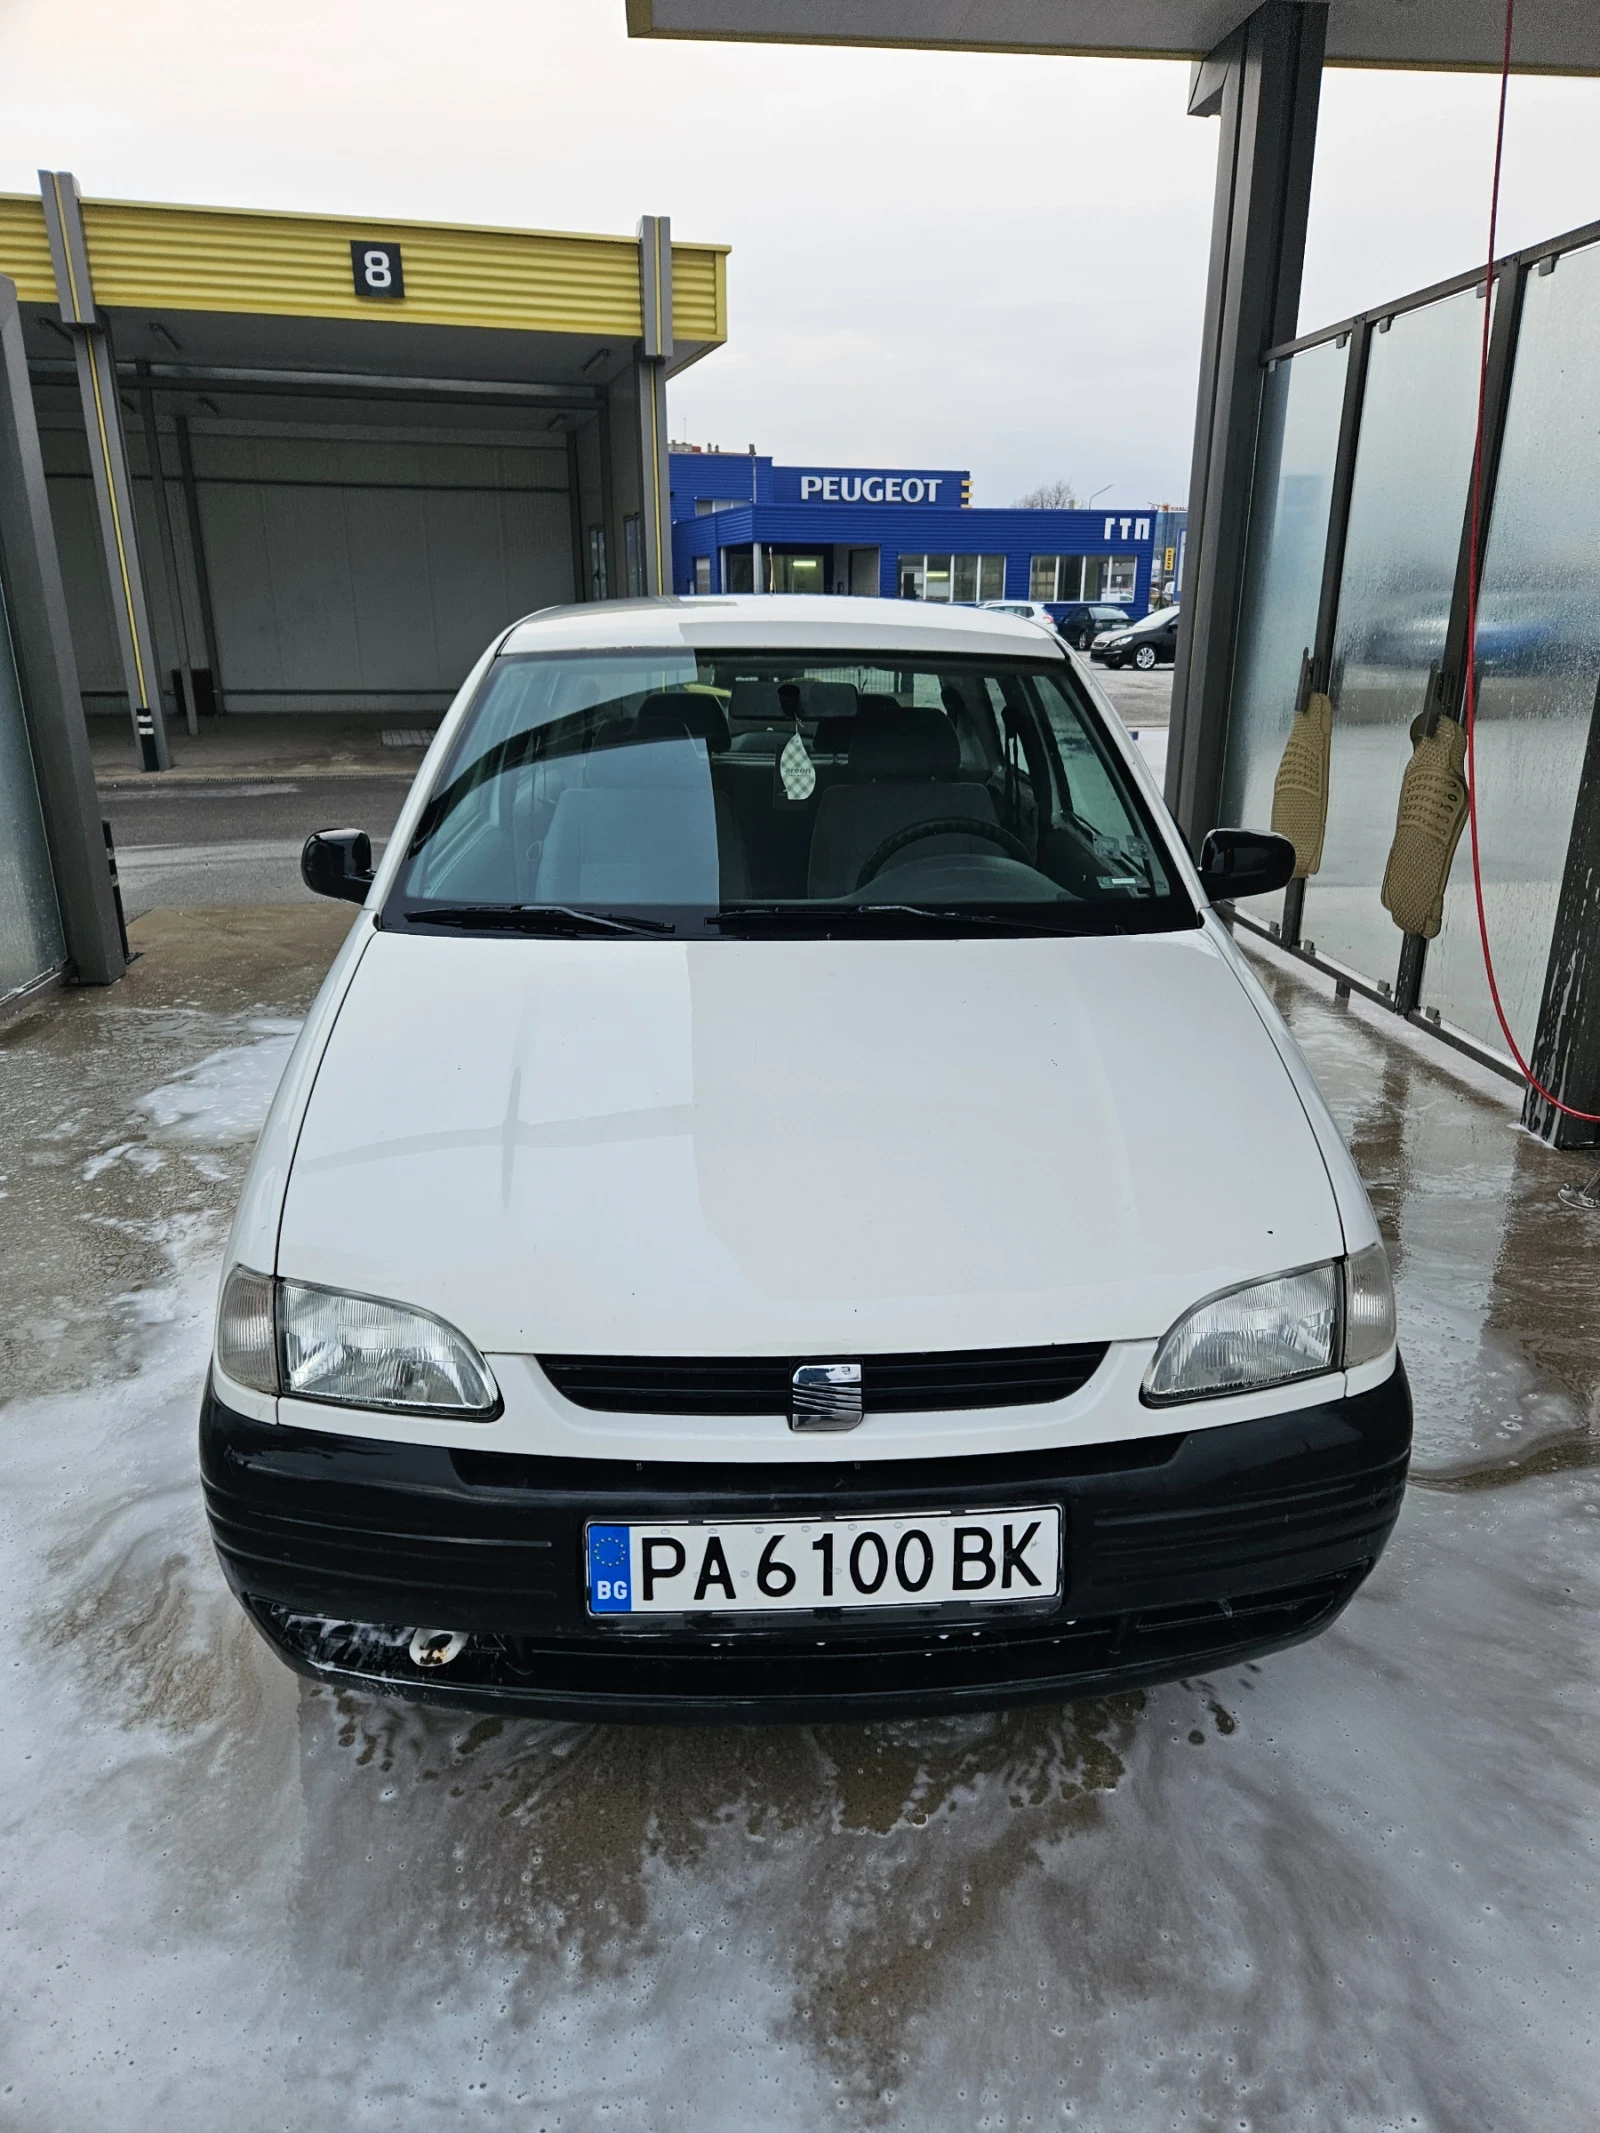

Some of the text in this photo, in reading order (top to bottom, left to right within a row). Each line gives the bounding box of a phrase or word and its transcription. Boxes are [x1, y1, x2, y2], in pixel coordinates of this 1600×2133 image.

[364, 251, 391, 287] 8
[801, 476, 942, 502] PEUGEOT
[1104, 518, 1150, 540] ГТП
[597, 1580, 628, 1600] BG
